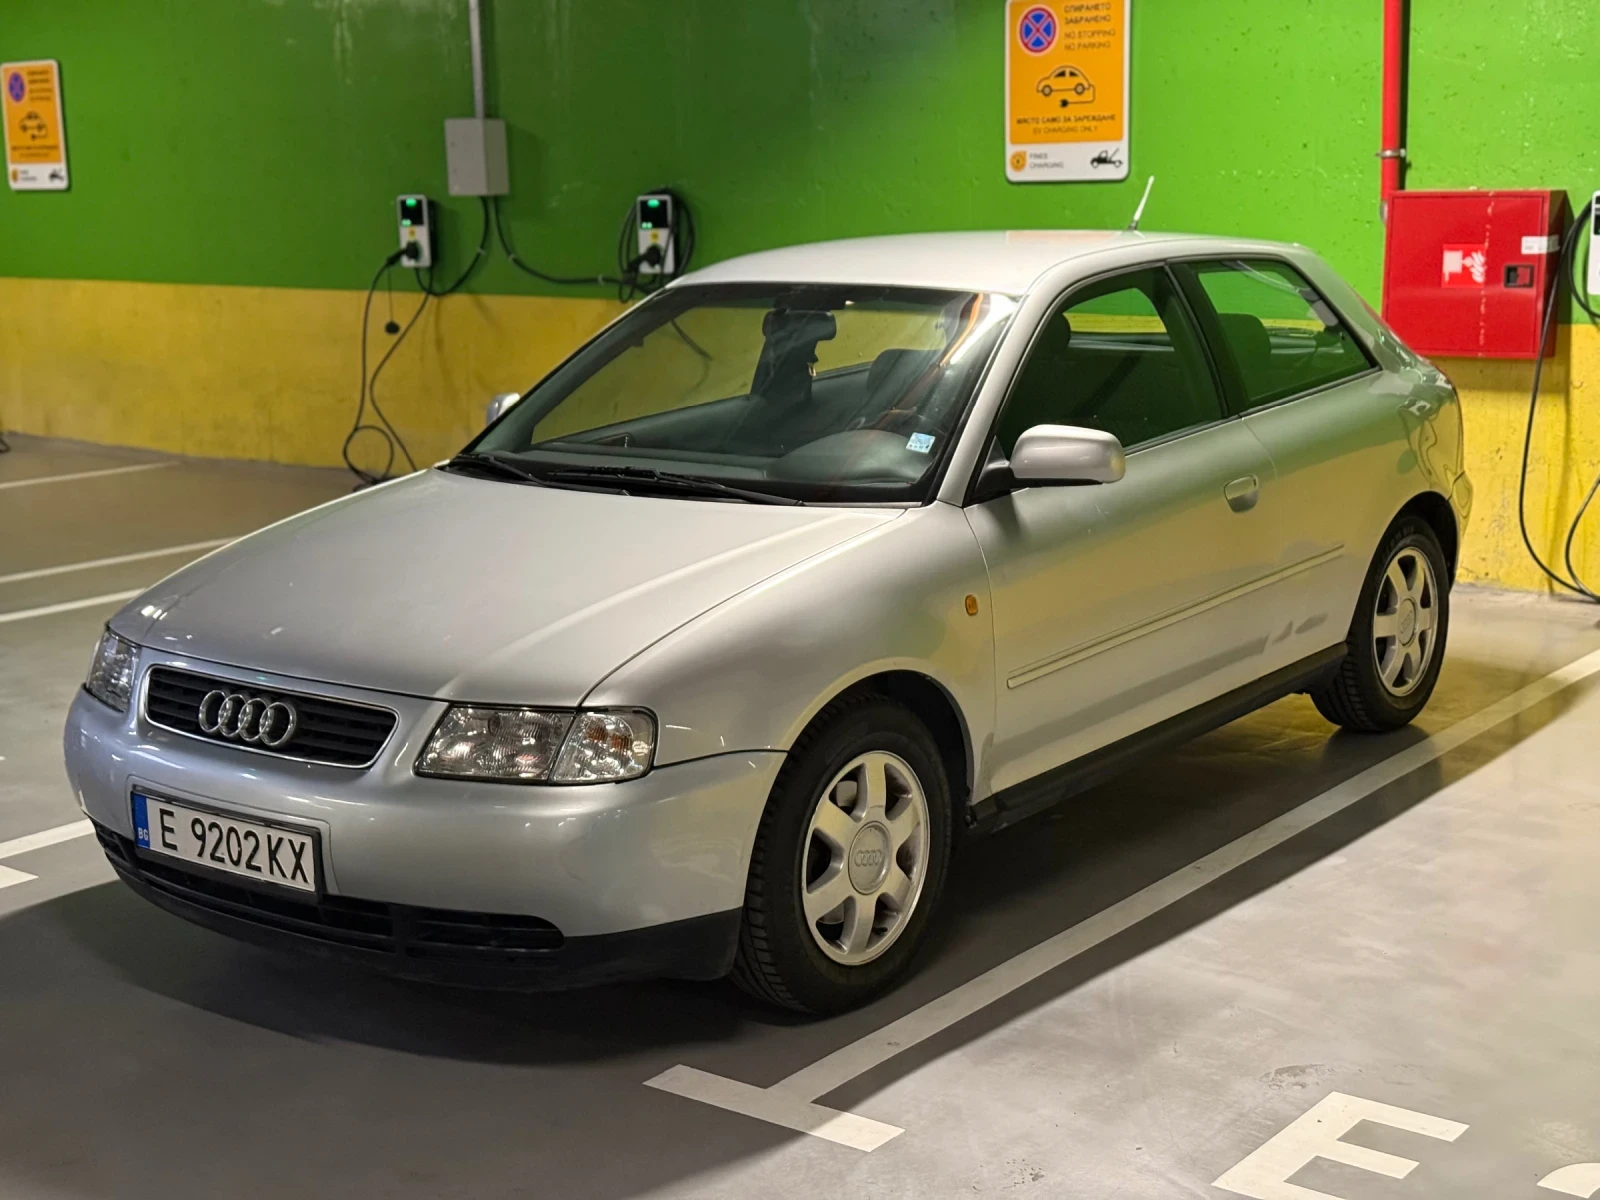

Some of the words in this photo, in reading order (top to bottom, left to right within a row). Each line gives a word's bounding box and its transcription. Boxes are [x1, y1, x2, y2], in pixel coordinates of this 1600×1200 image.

[1064, 2, 1112, 13] СПИРАНЕТО
[1064, 14, 1111, 25] ЗАБРАНЕНО
[1064, 31, 1076, 39] NO
[1078, 28, 1116, 38] STOPPING
[1064, 43, 1076, 51] NO
[1078, 41, 1111, 50] PARKING
[137, 827, 149, 841] BG
[159, 808, 178, 851] E
[190, 817, 310, 884] 9202KX
